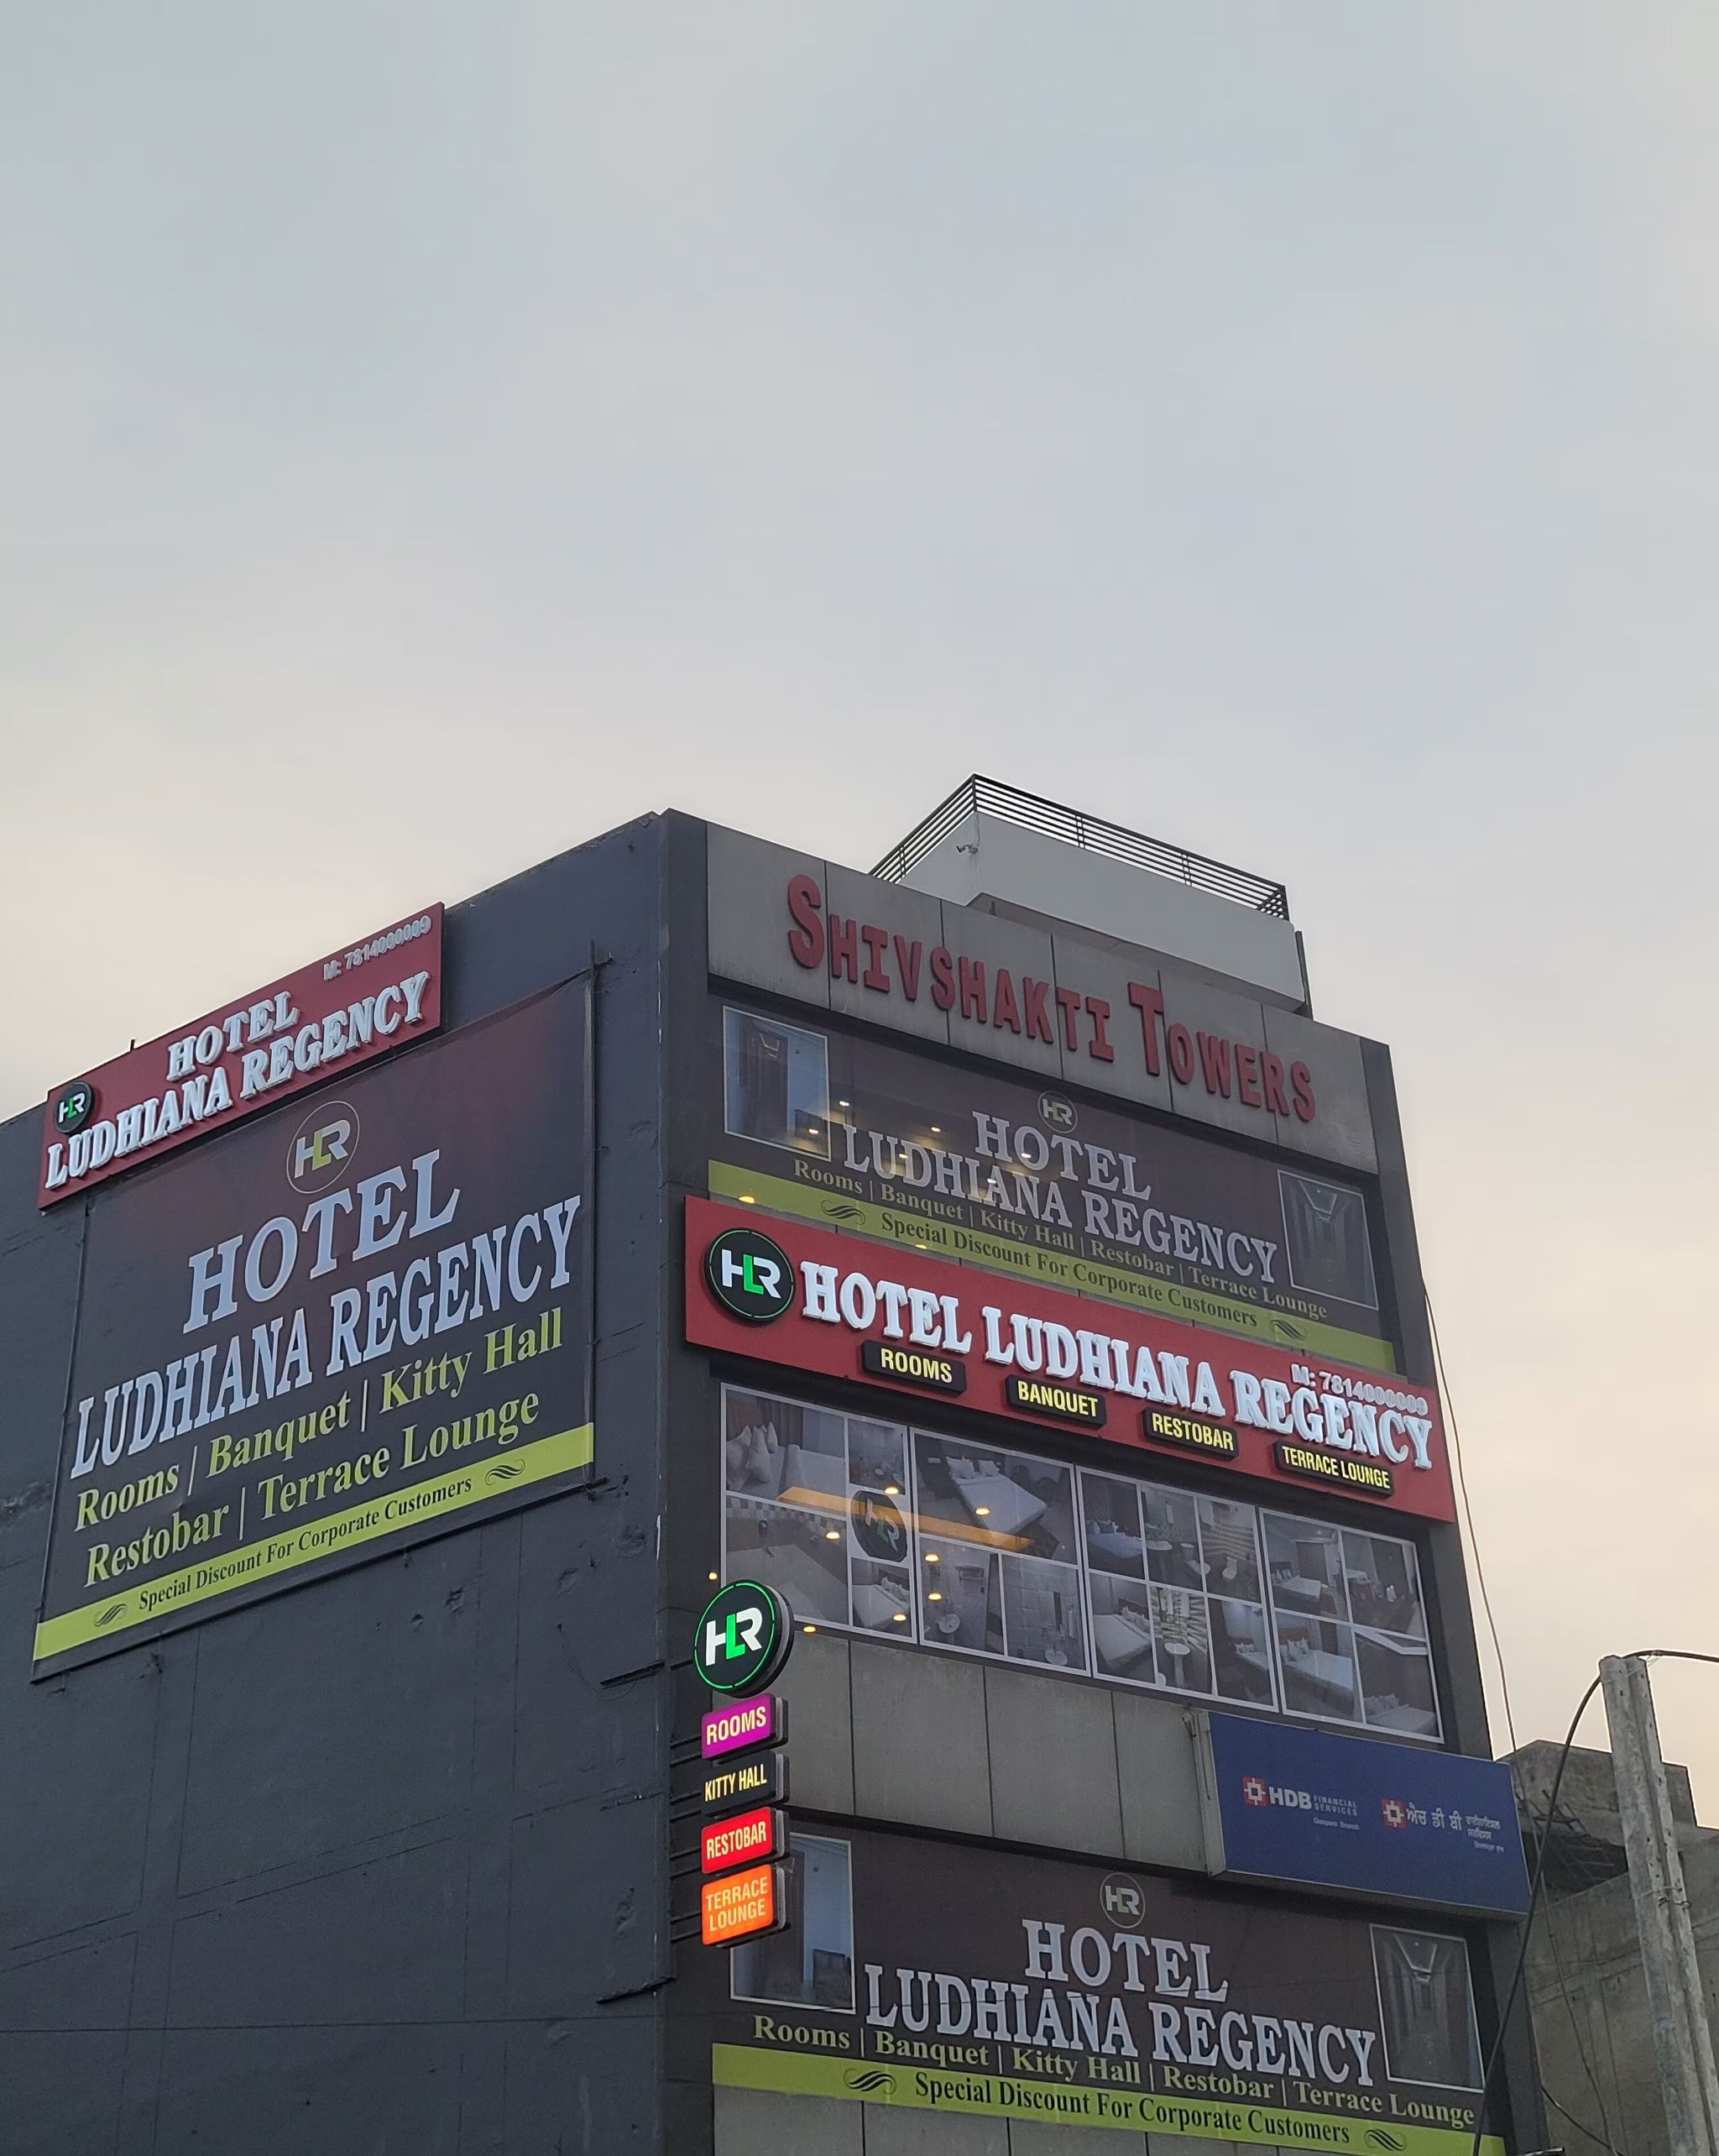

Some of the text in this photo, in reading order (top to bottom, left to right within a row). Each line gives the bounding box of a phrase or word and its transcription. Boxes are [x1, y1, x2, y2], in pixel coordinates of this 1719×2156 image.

[323, 960, 342, 981] M:
[786, 874, 1315, 1122] SHIVSHAKTI TOWERS
[166, 992, 300, 1081] HOTEL
[44, 971, 431, 1191] LUDHIANA REGENCY
[973, 1111, 1152, 1201] HOTEL
[183, 1149, 460, 1333] HOTEL
[793, 1159, 1327, 1318] Rooms Banquet Kitty Hall Restobar Terrace Lounge
[843, 1123, 1277, 1285] LUDHIANA REGENCY
[721, 1248, 781, 1299] HLR
[881, 1212, 1257, 1327] Special Discount For Corporate Customers
[70, 1196, 581, 1479] LUDHIANA REGENCY
[800, 1260, 1433, 1469] HOTEL LUDHIANA REGENCY
[880, 1348, 953, 1384] ROOMS
[1017, 1380, 1098, 1417] BANQUET
[1291, 1363, 1316, 1387] M:
[75, 1307, 563, 1532] Rooms Banquet Kitty Hall
[1152, 1413, 1234, 1452] RESTOBAR
[84, 1391, 540, 1587] Restobar Terrace Lounge
[1282, 1445, 1391, 1489] TERRACE LOUNGE
[138, 1477, 473, 1611] Special Discount For Corporate Customers
[705, 1606, 762, 1667] HLR
[706, 1705, 767, 1745] ROOMS
[704, 1763, 767, 1803] KITTY HALL
[1268, 1786, 1312, 1810] HDB
[1313, 1795, 1357, 1808] FINANCIAL
[1314, 1803, 1357, 1816] SERVICES
[706, 1821, 767, 1860] RESTOBAR
[705, 1876, 768, 1913] TERRACE
[708, 1897, 765, 1933] LOUNGE
[1022, 1918, 1229, 2002] HOTEL
[864, 1964, 1377, 2088] LUDHIANA REGENCY
[753, 2015, 1475, 2128] Rooms Banquet Kitty Hall Restobar Terrace Lounge
[915, 2071, 1350, 2145] Special Discount For Corporate Customers
